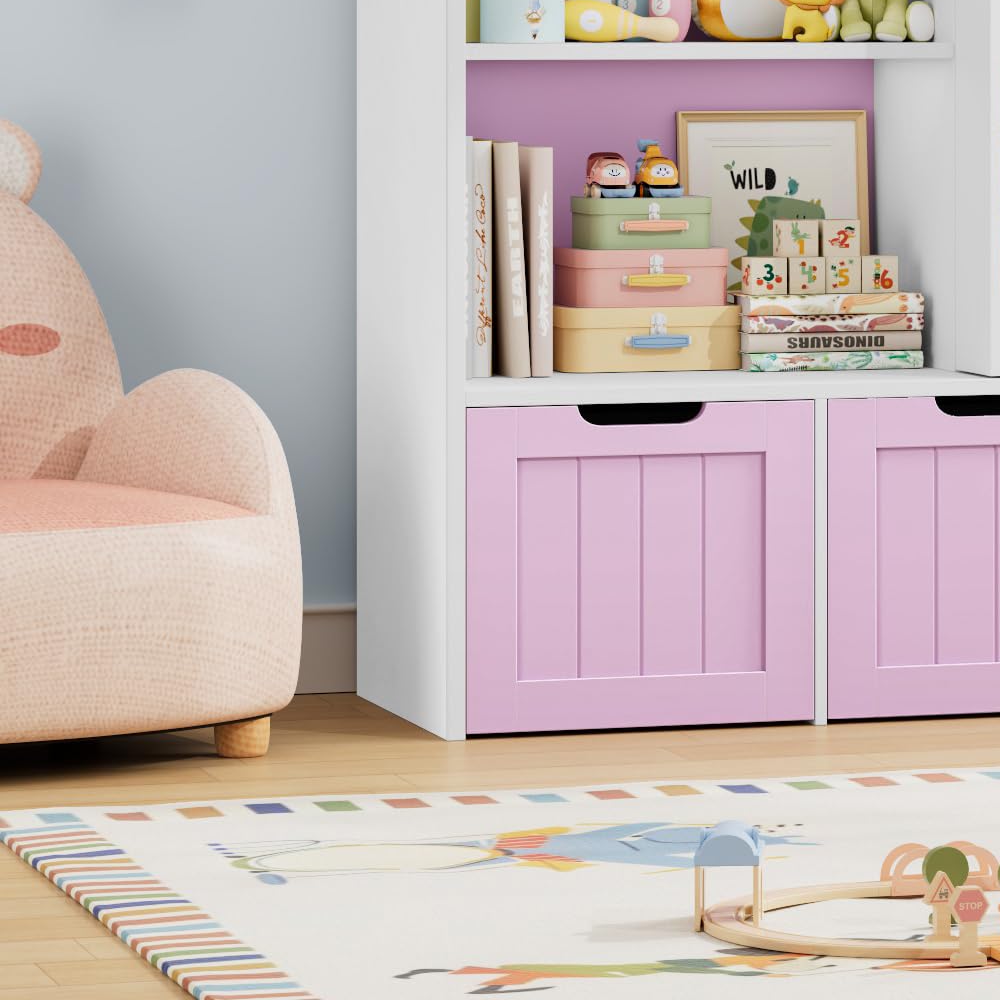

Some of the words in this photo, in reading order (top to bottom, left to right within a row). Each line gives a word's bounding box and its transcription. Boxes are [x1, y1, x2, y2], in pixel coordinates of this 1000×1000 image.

[730, 167, 777, 191] WILD
[797, 238, 805, 255] 1
[836, 229, 850, 249] 2
[762, 263, 775, 282] 3
[801, 264, 814, 284] 4
[838, 267, 850, 287] 5
[880, 269, 894, 290] 6
[786, 335, 885, 350] DINOSAURS
[959, 901, 983, 911] STOP
